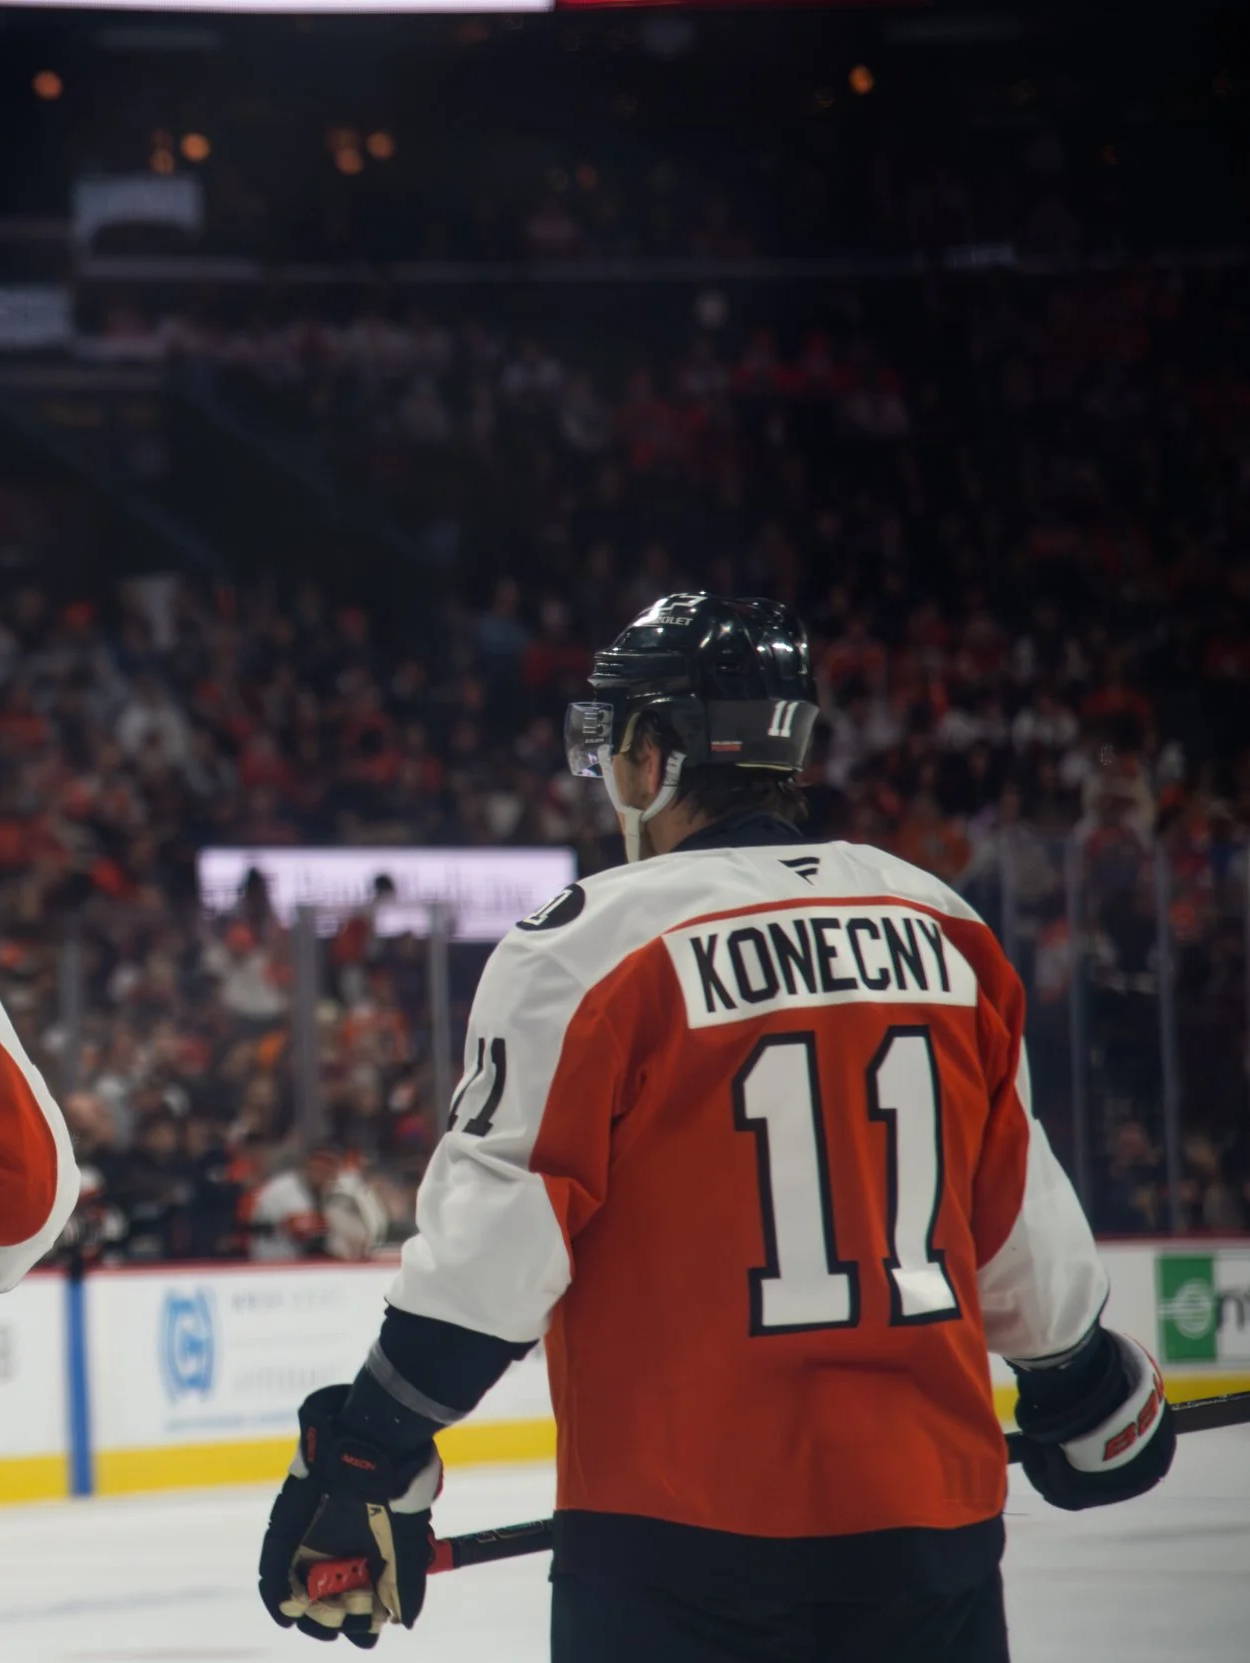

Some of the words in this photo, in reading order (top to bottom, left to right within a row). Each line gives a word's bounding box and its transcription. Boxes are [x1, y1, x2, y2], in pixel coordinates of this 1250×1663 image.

[767, 700, 799, 738] 11
[689, 916, 952, 1013] KONECNY
[733, 1025, 961, 1337] 11
